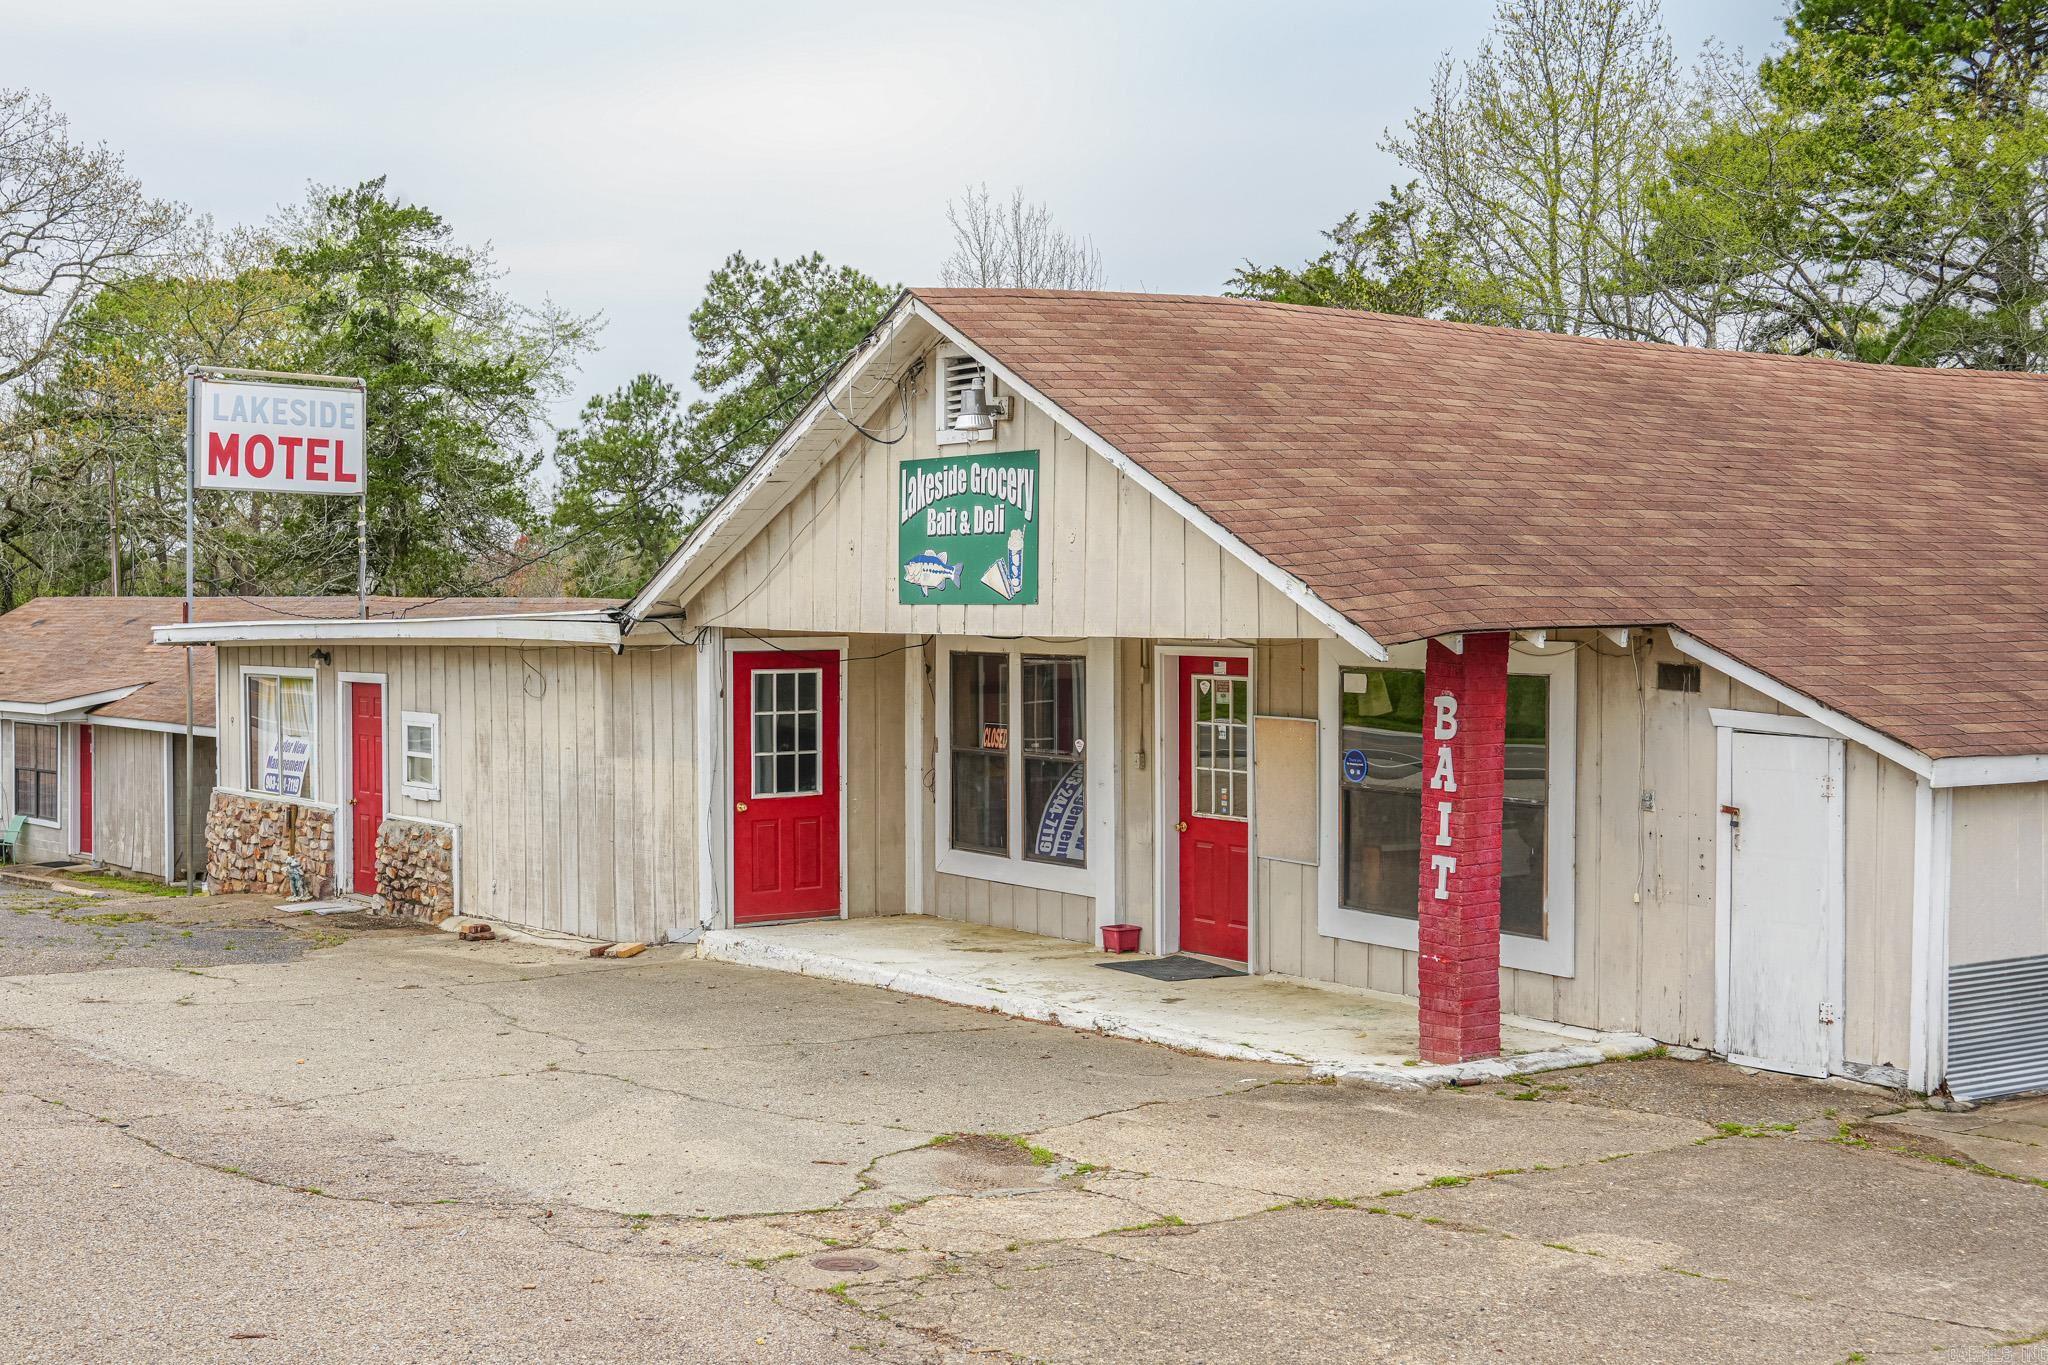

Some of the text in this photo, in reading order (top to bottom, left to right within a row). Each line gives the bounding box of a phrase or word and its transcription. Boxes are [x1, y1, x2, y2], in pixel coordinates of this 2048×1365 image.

[213, 393, 355, 430] LAKESIDE
[208, 432, 357, 483] MOTEL
[902, 462, 1034, 524] Lakeside Grocery
[927, 504, 1005, 537] Bait & Deli
[274, 740, 308, 755] Uder New
[983, 727, 1009, 749] CLOSED
[266, 755, 306, 772] Mangement
[1430, 695, 1459, 901] BAIT
